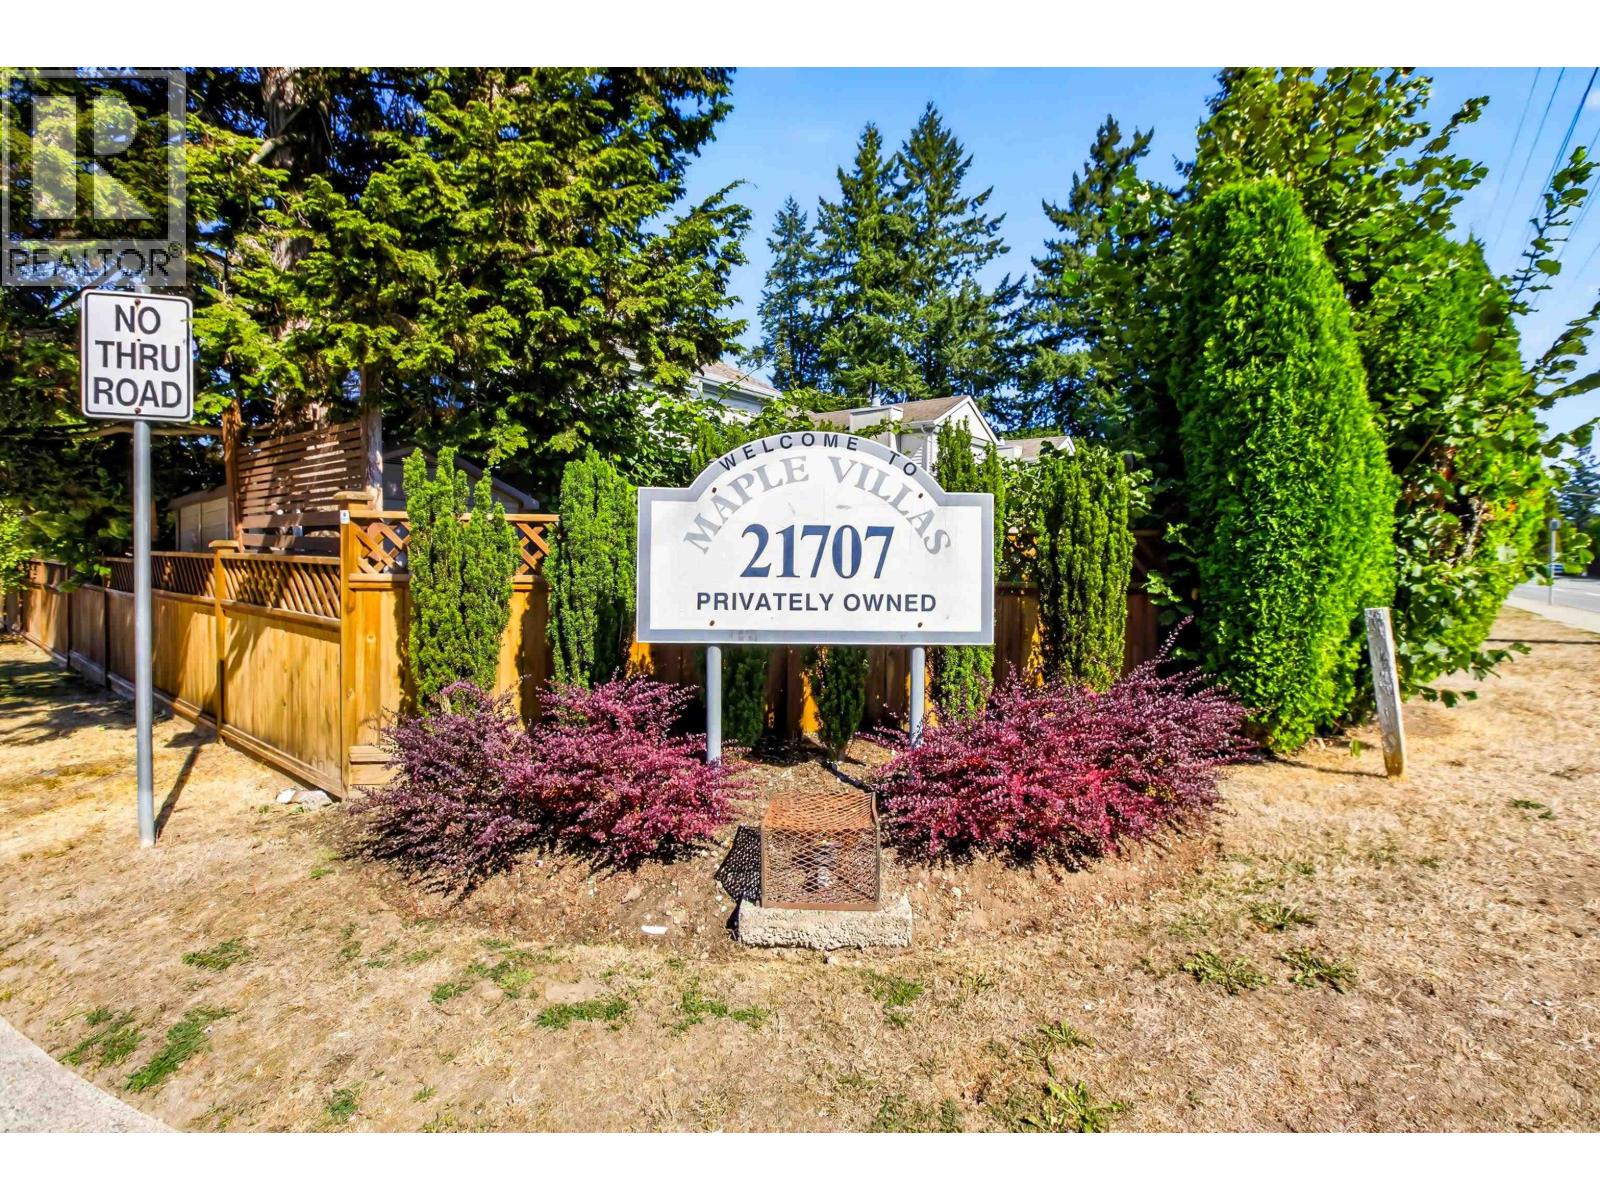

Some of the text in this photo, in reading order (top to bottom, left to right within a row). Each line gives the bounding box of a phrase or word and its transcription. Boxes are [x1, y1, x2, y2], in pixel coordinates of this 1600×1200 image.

[115, 305, 161, 335] NO
[95, 340, 181, 373] THRU
[93, 377, 182, 408] ROAD
[719, 433, 917, 476] WELCOME TO
[683, 456, 951, 555] MAPLE VILLAS
[740, 523, 895, 579] 21707
[696, 592, 937, 612] PRIVATELY OWNED
